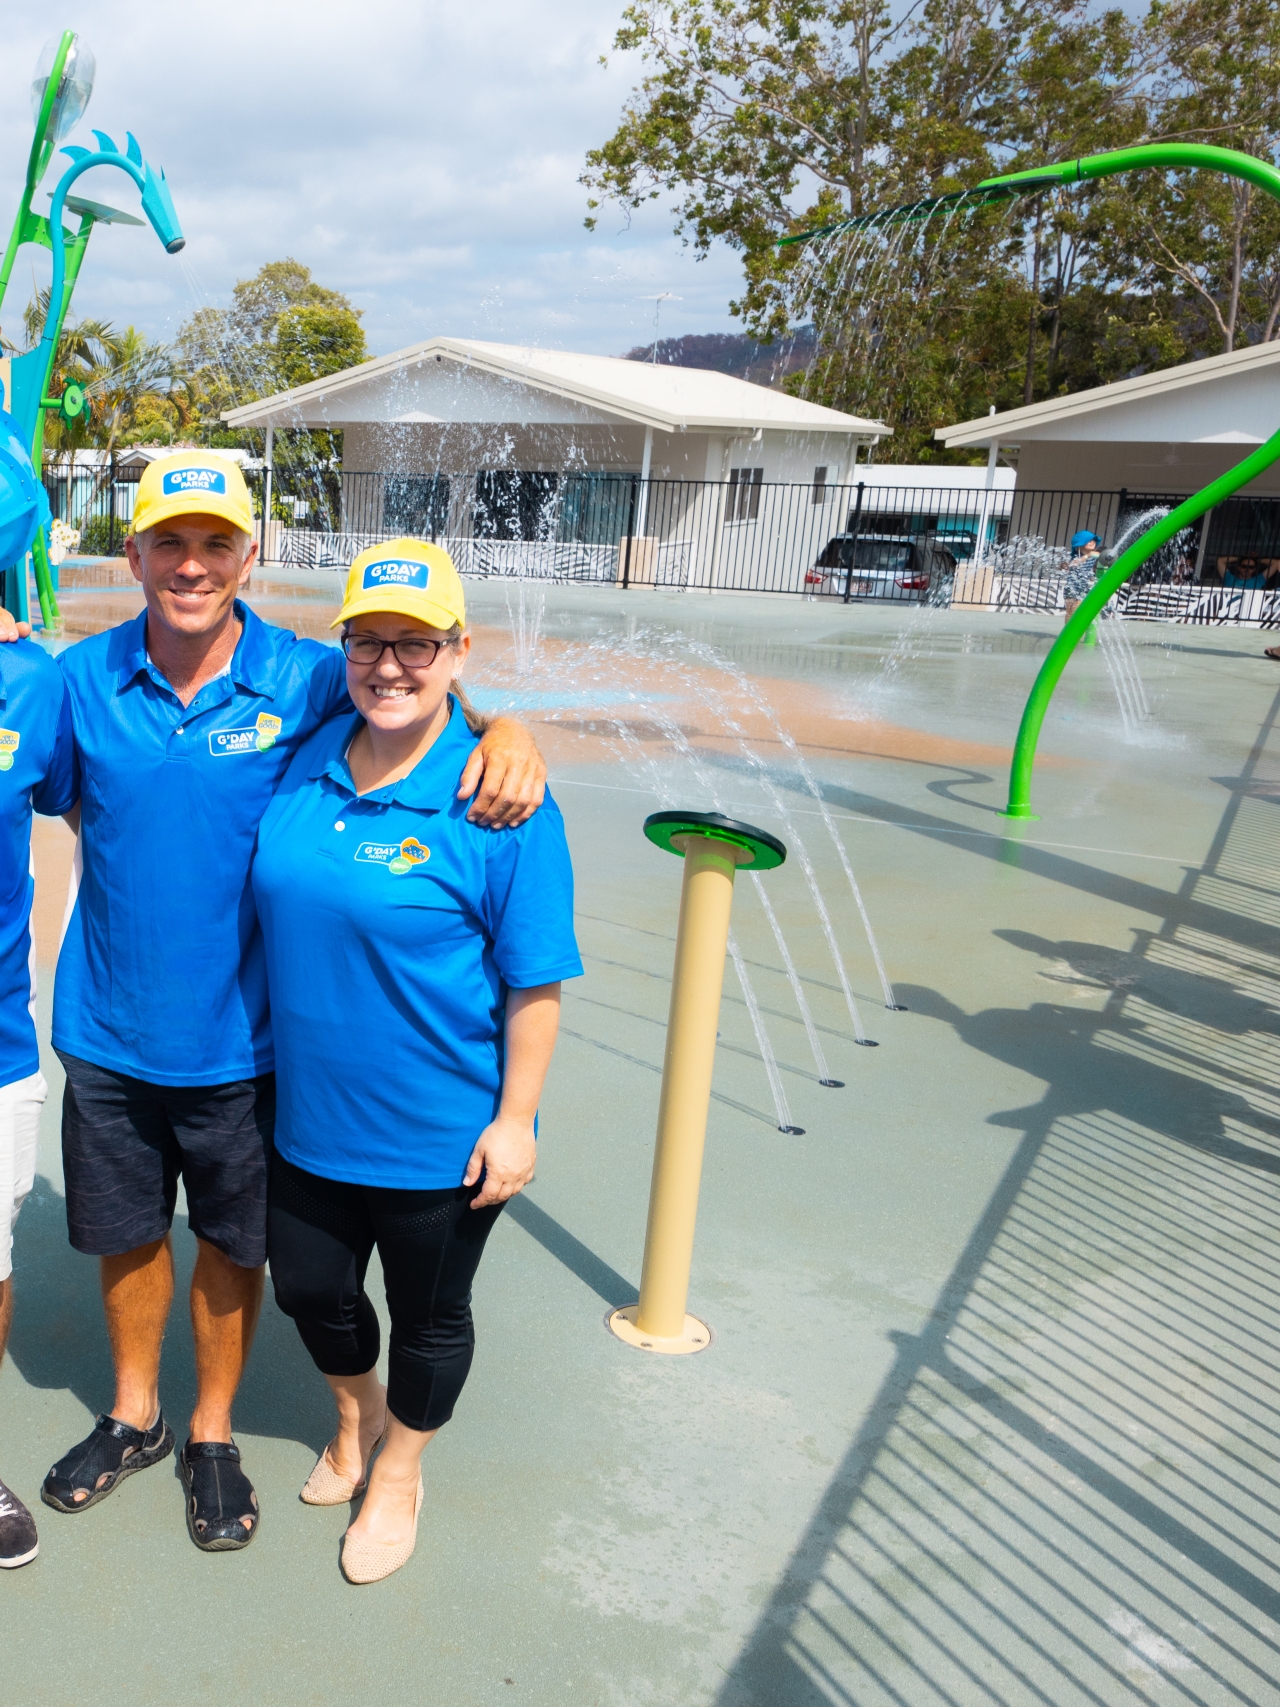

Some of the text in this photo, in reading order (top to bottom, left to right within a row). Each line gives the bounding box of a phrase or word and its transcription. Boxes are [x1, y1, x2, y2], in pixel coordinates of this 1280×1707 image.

[170, 470, 218, 484] G'DAY
[180, 481, 209, 489] PARKS
[370, 563, 420, 577] G'DAY
[378, 574, 409, 583] PARKS
[217, 732, 254, 745] G'DAY
[226, 742, 249, 751] PARKS
[364, 846, 397, 856] G'DAY
